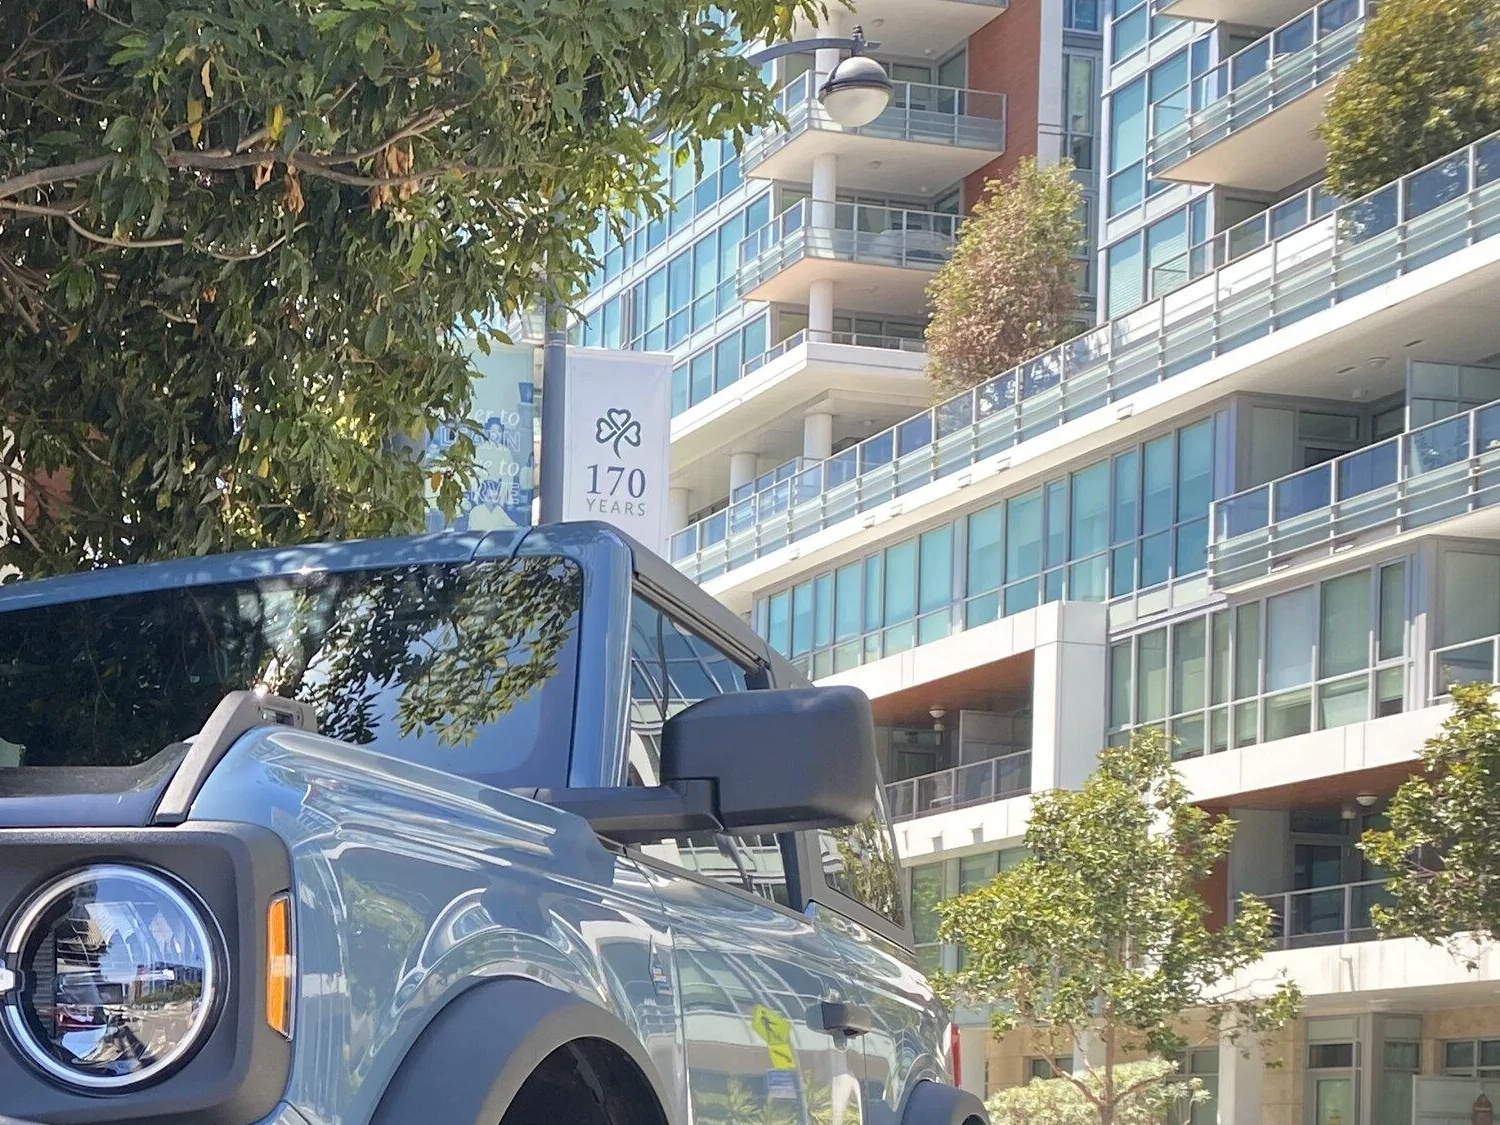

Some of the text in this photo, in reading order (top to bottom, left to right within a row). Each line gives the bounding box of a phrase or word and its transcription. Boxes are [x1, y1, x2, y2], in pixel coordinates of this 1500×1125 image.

[500, 409, 520, 426] to
[499, 459, 520, 477] to
[586, 463, 646, 499] 170
[586, 498, 646, 517] YEARS
